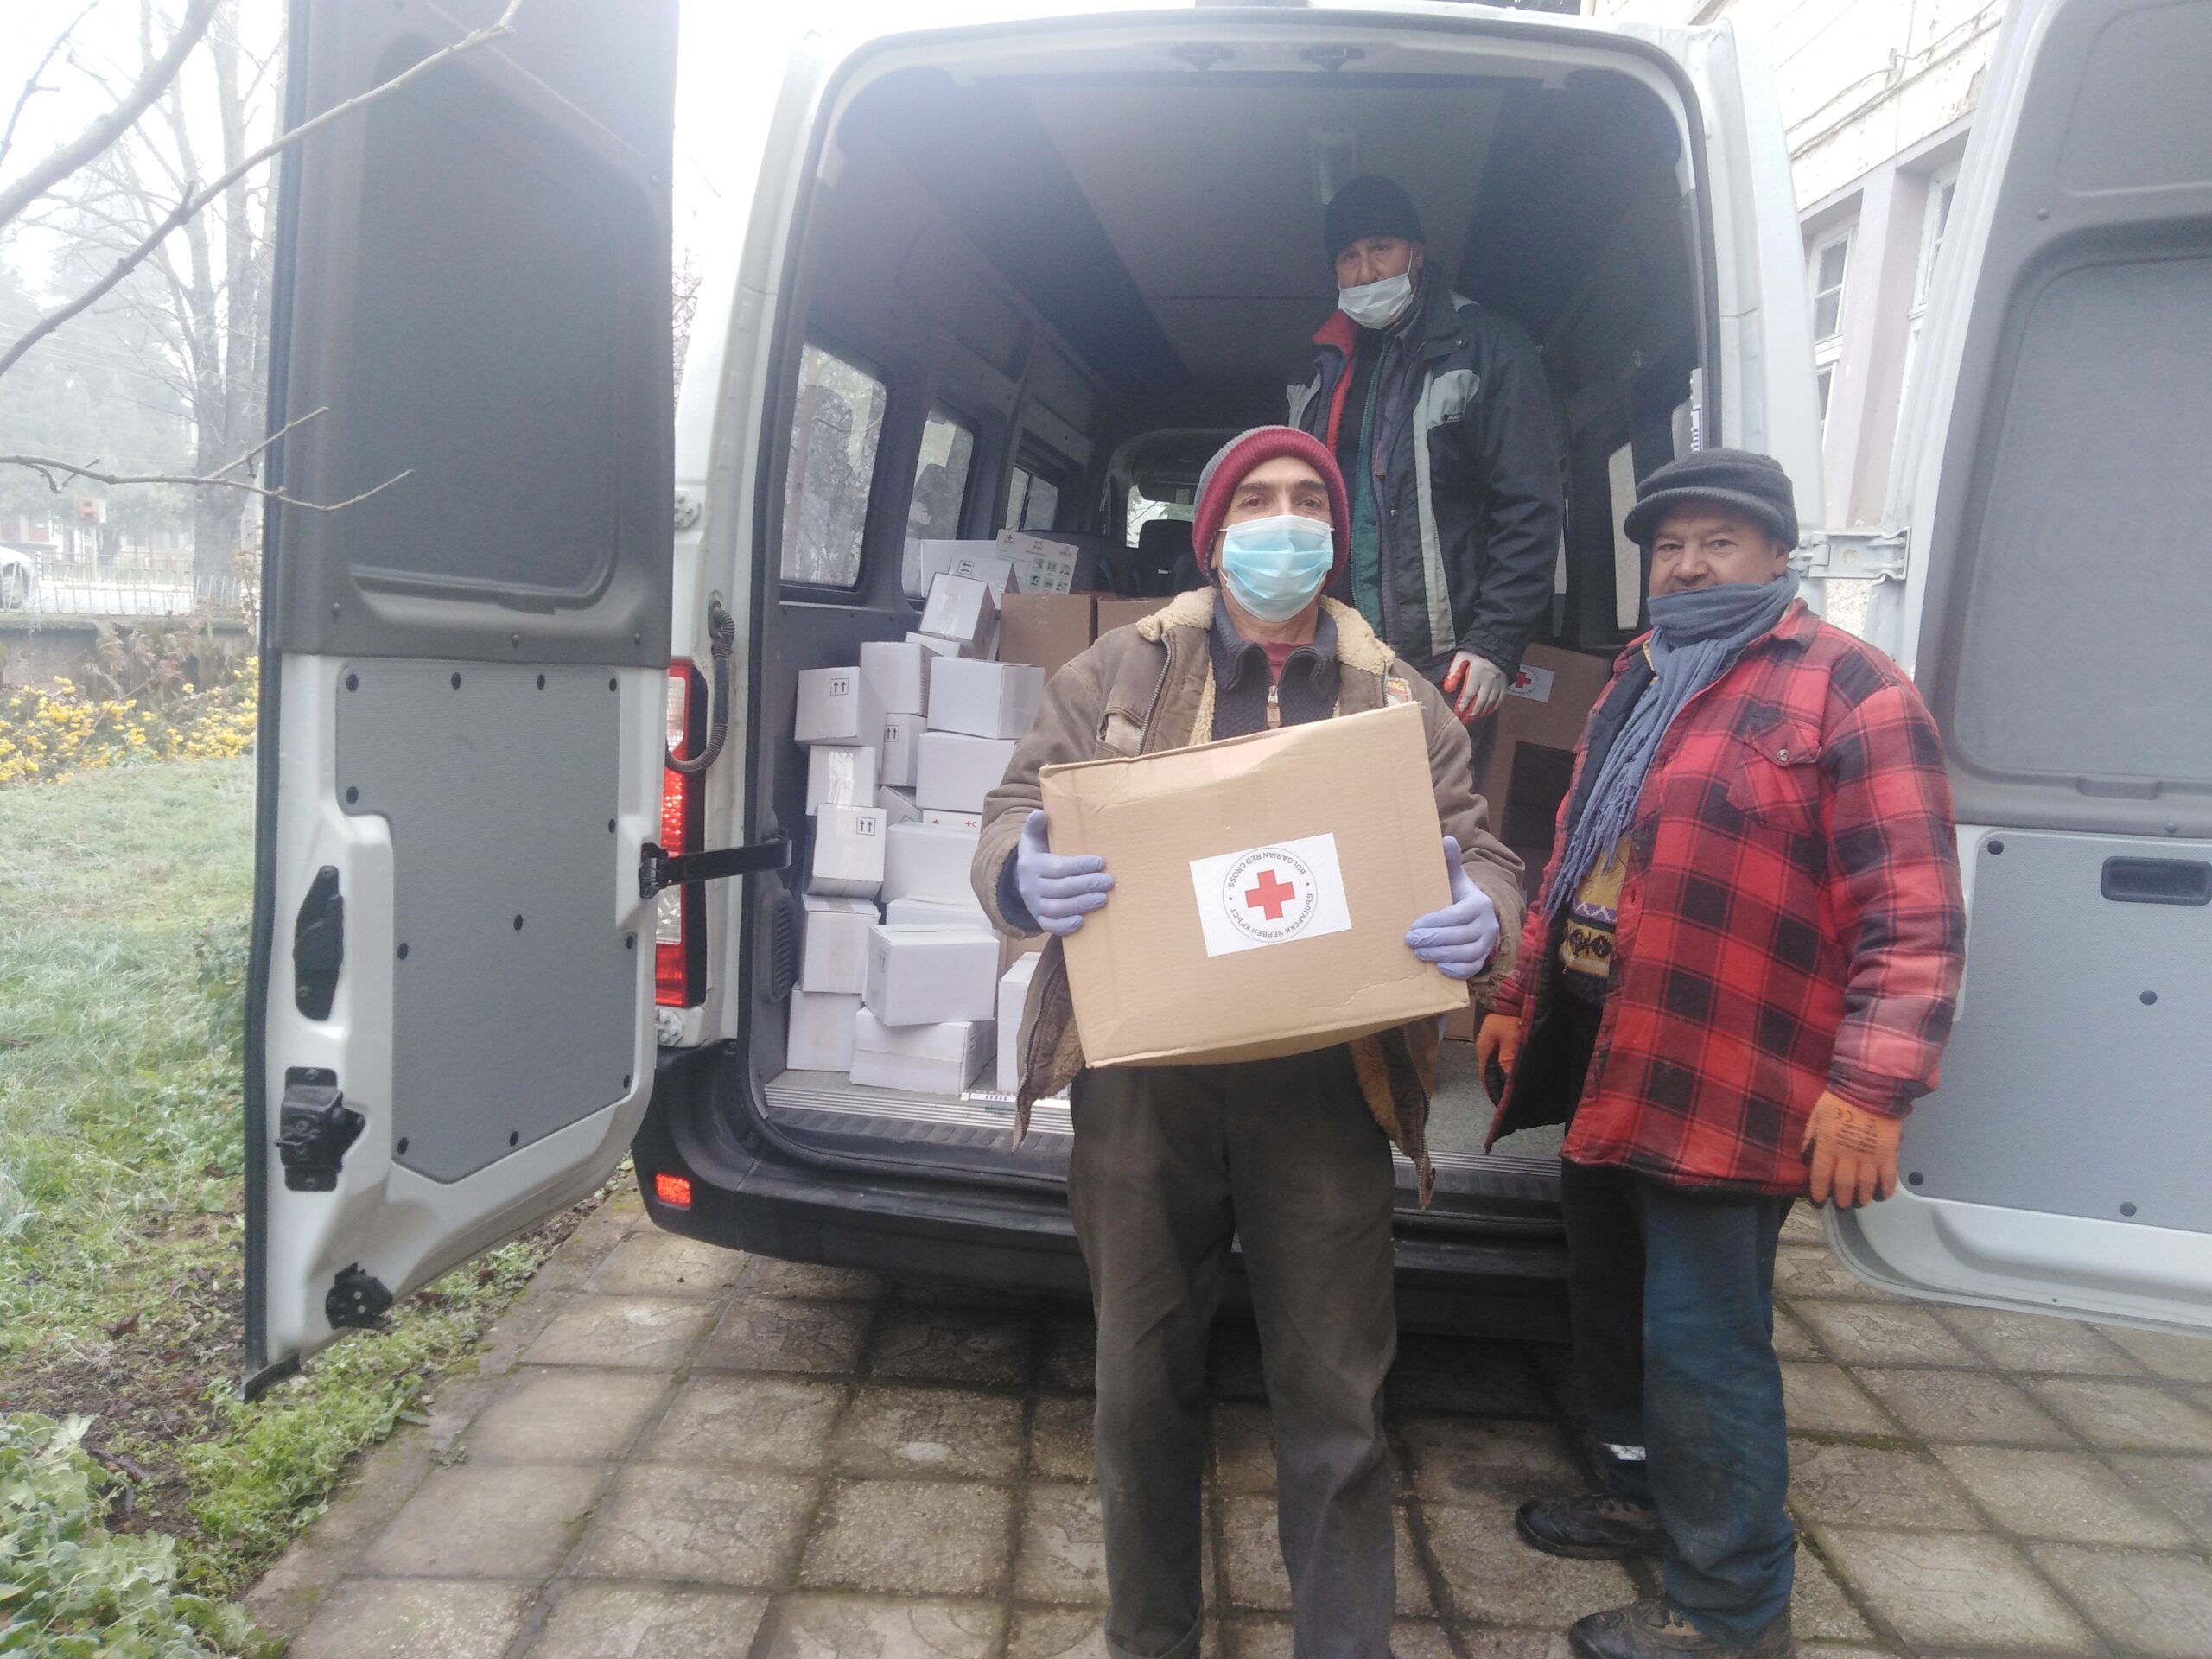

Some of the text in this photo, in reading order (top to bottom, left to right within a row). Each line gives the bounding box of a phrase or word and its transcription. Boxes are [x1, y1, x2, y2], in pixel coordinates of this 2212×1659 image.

[1228, 851, 1306, 888] BULGARIAN RED CROSS
[1230, 893, 1313, 938] БЪЛГАРСКИ ЧЕРВЕН КРЪСТ
